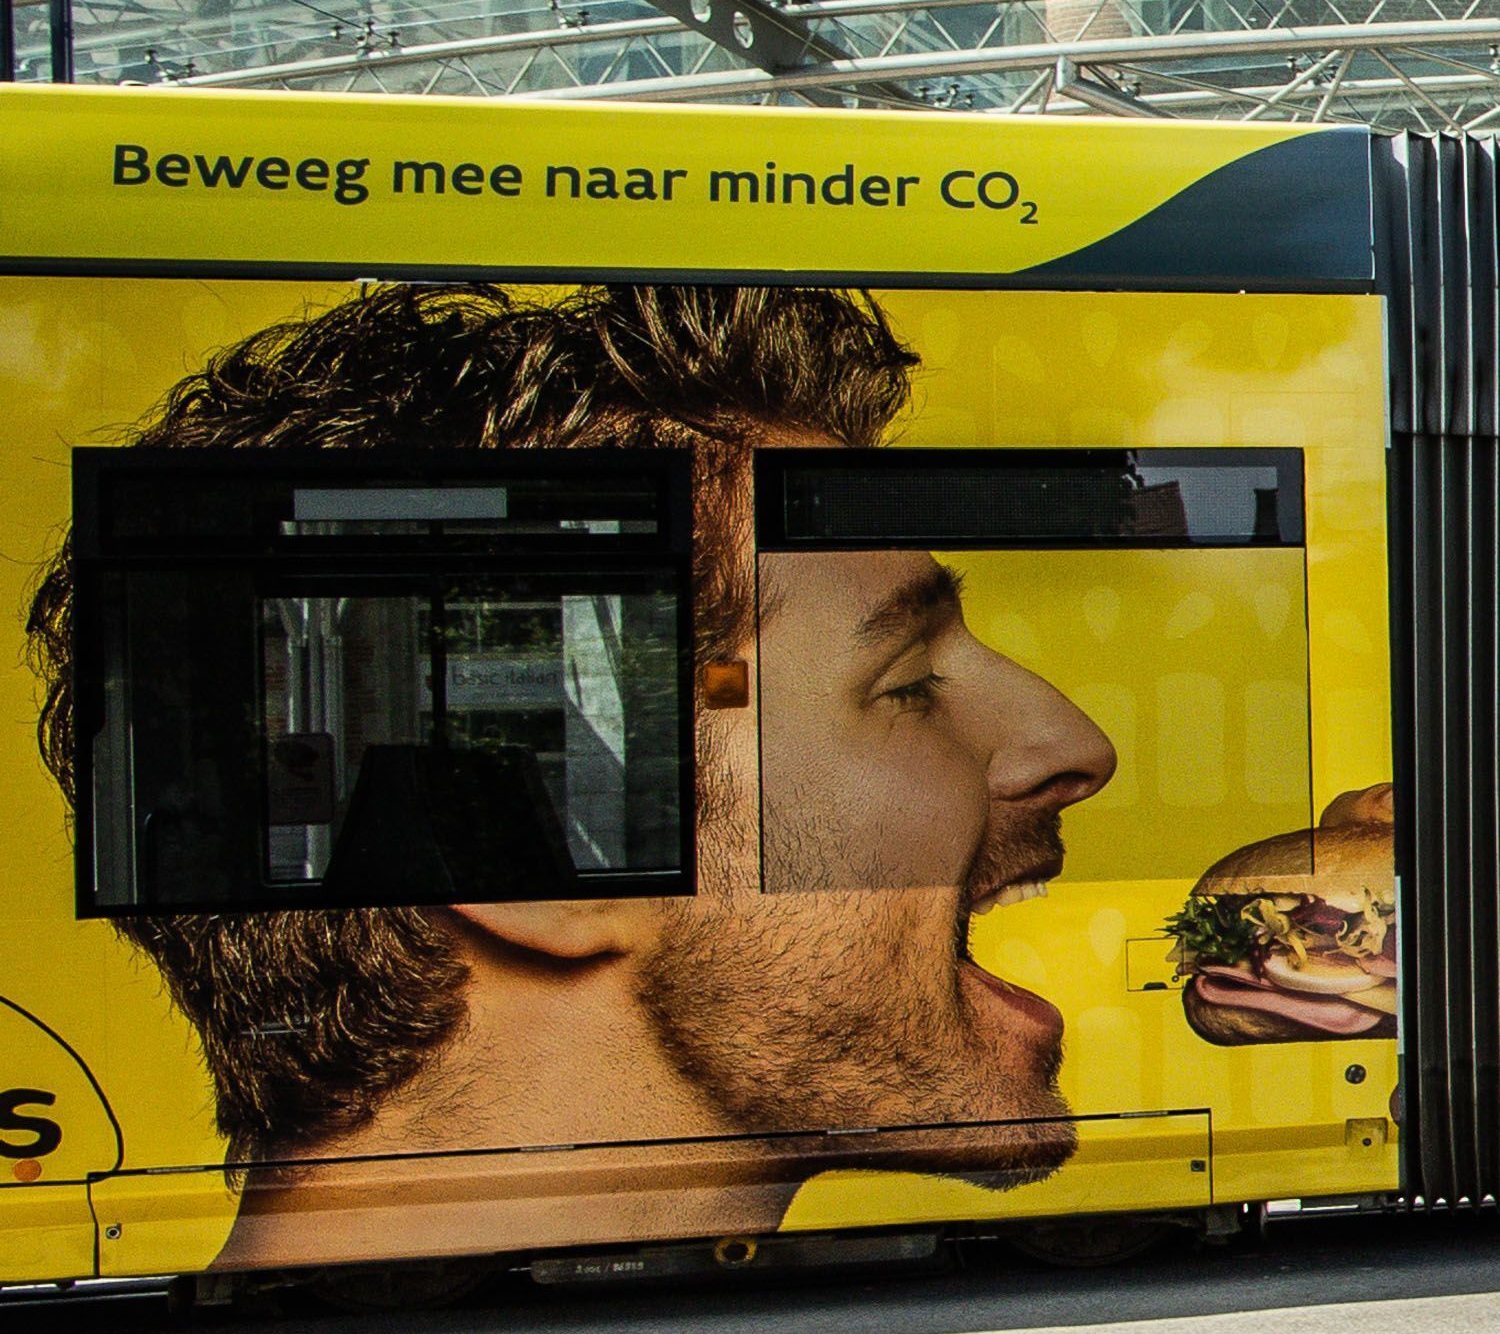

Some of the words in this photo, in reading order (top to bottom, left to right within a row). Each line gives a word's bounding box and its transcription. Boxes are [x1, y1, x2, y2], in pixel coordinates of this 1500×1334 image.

[113, 145, 371, 206] Beweeg
[393, 161, 522, 196] mee
[546, 166, 687, 201] naar
[710, 164, 920, 206] minder
